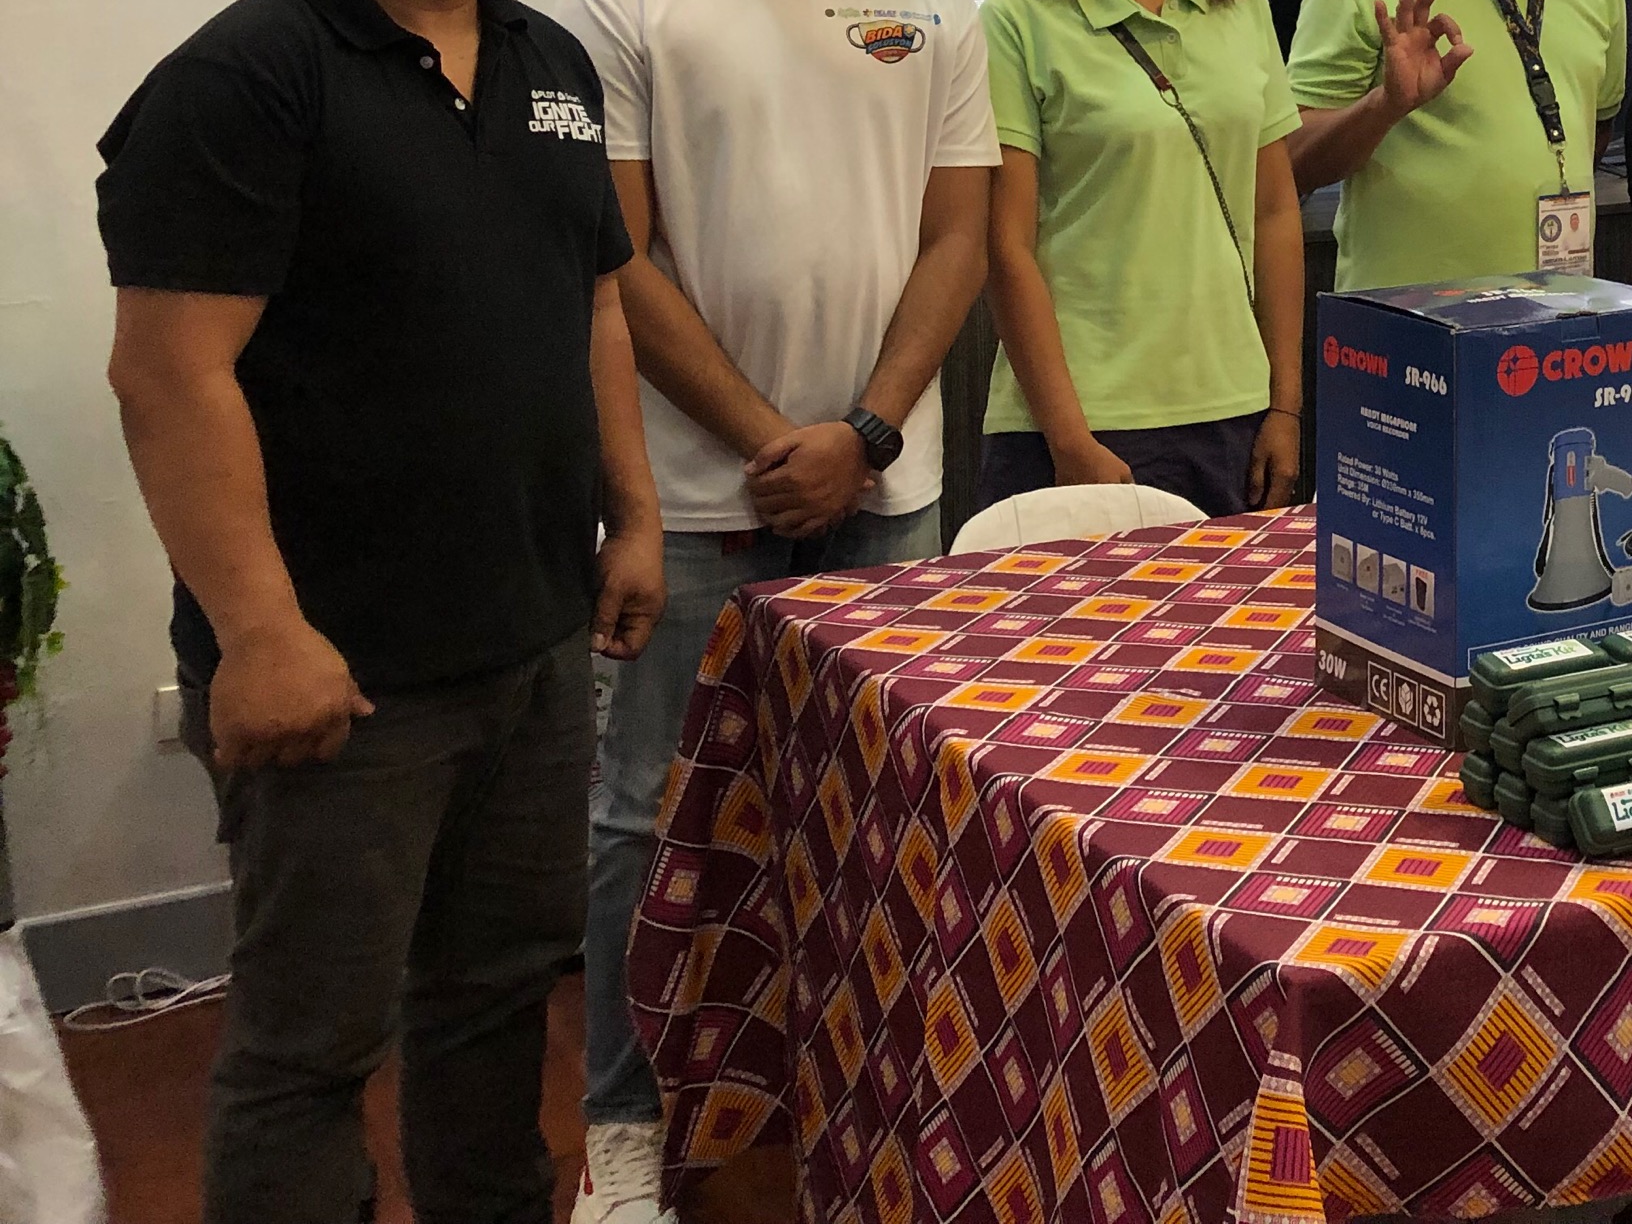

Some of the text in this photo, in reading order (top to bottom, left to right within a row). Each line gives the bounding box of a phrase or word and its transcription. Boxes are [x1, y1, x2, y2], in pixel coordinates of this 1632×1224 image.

[865, 25, 903, 44] BIDA
[531, 101, 592, 123] IGNITE
[528, 120, 602, 144] OUR FIGHT
[1340, 345, 1448, 395] CROWN SR-966
[1589, 627, 1607, 640] AND
[1318, 649, 1347, 680] 30W
